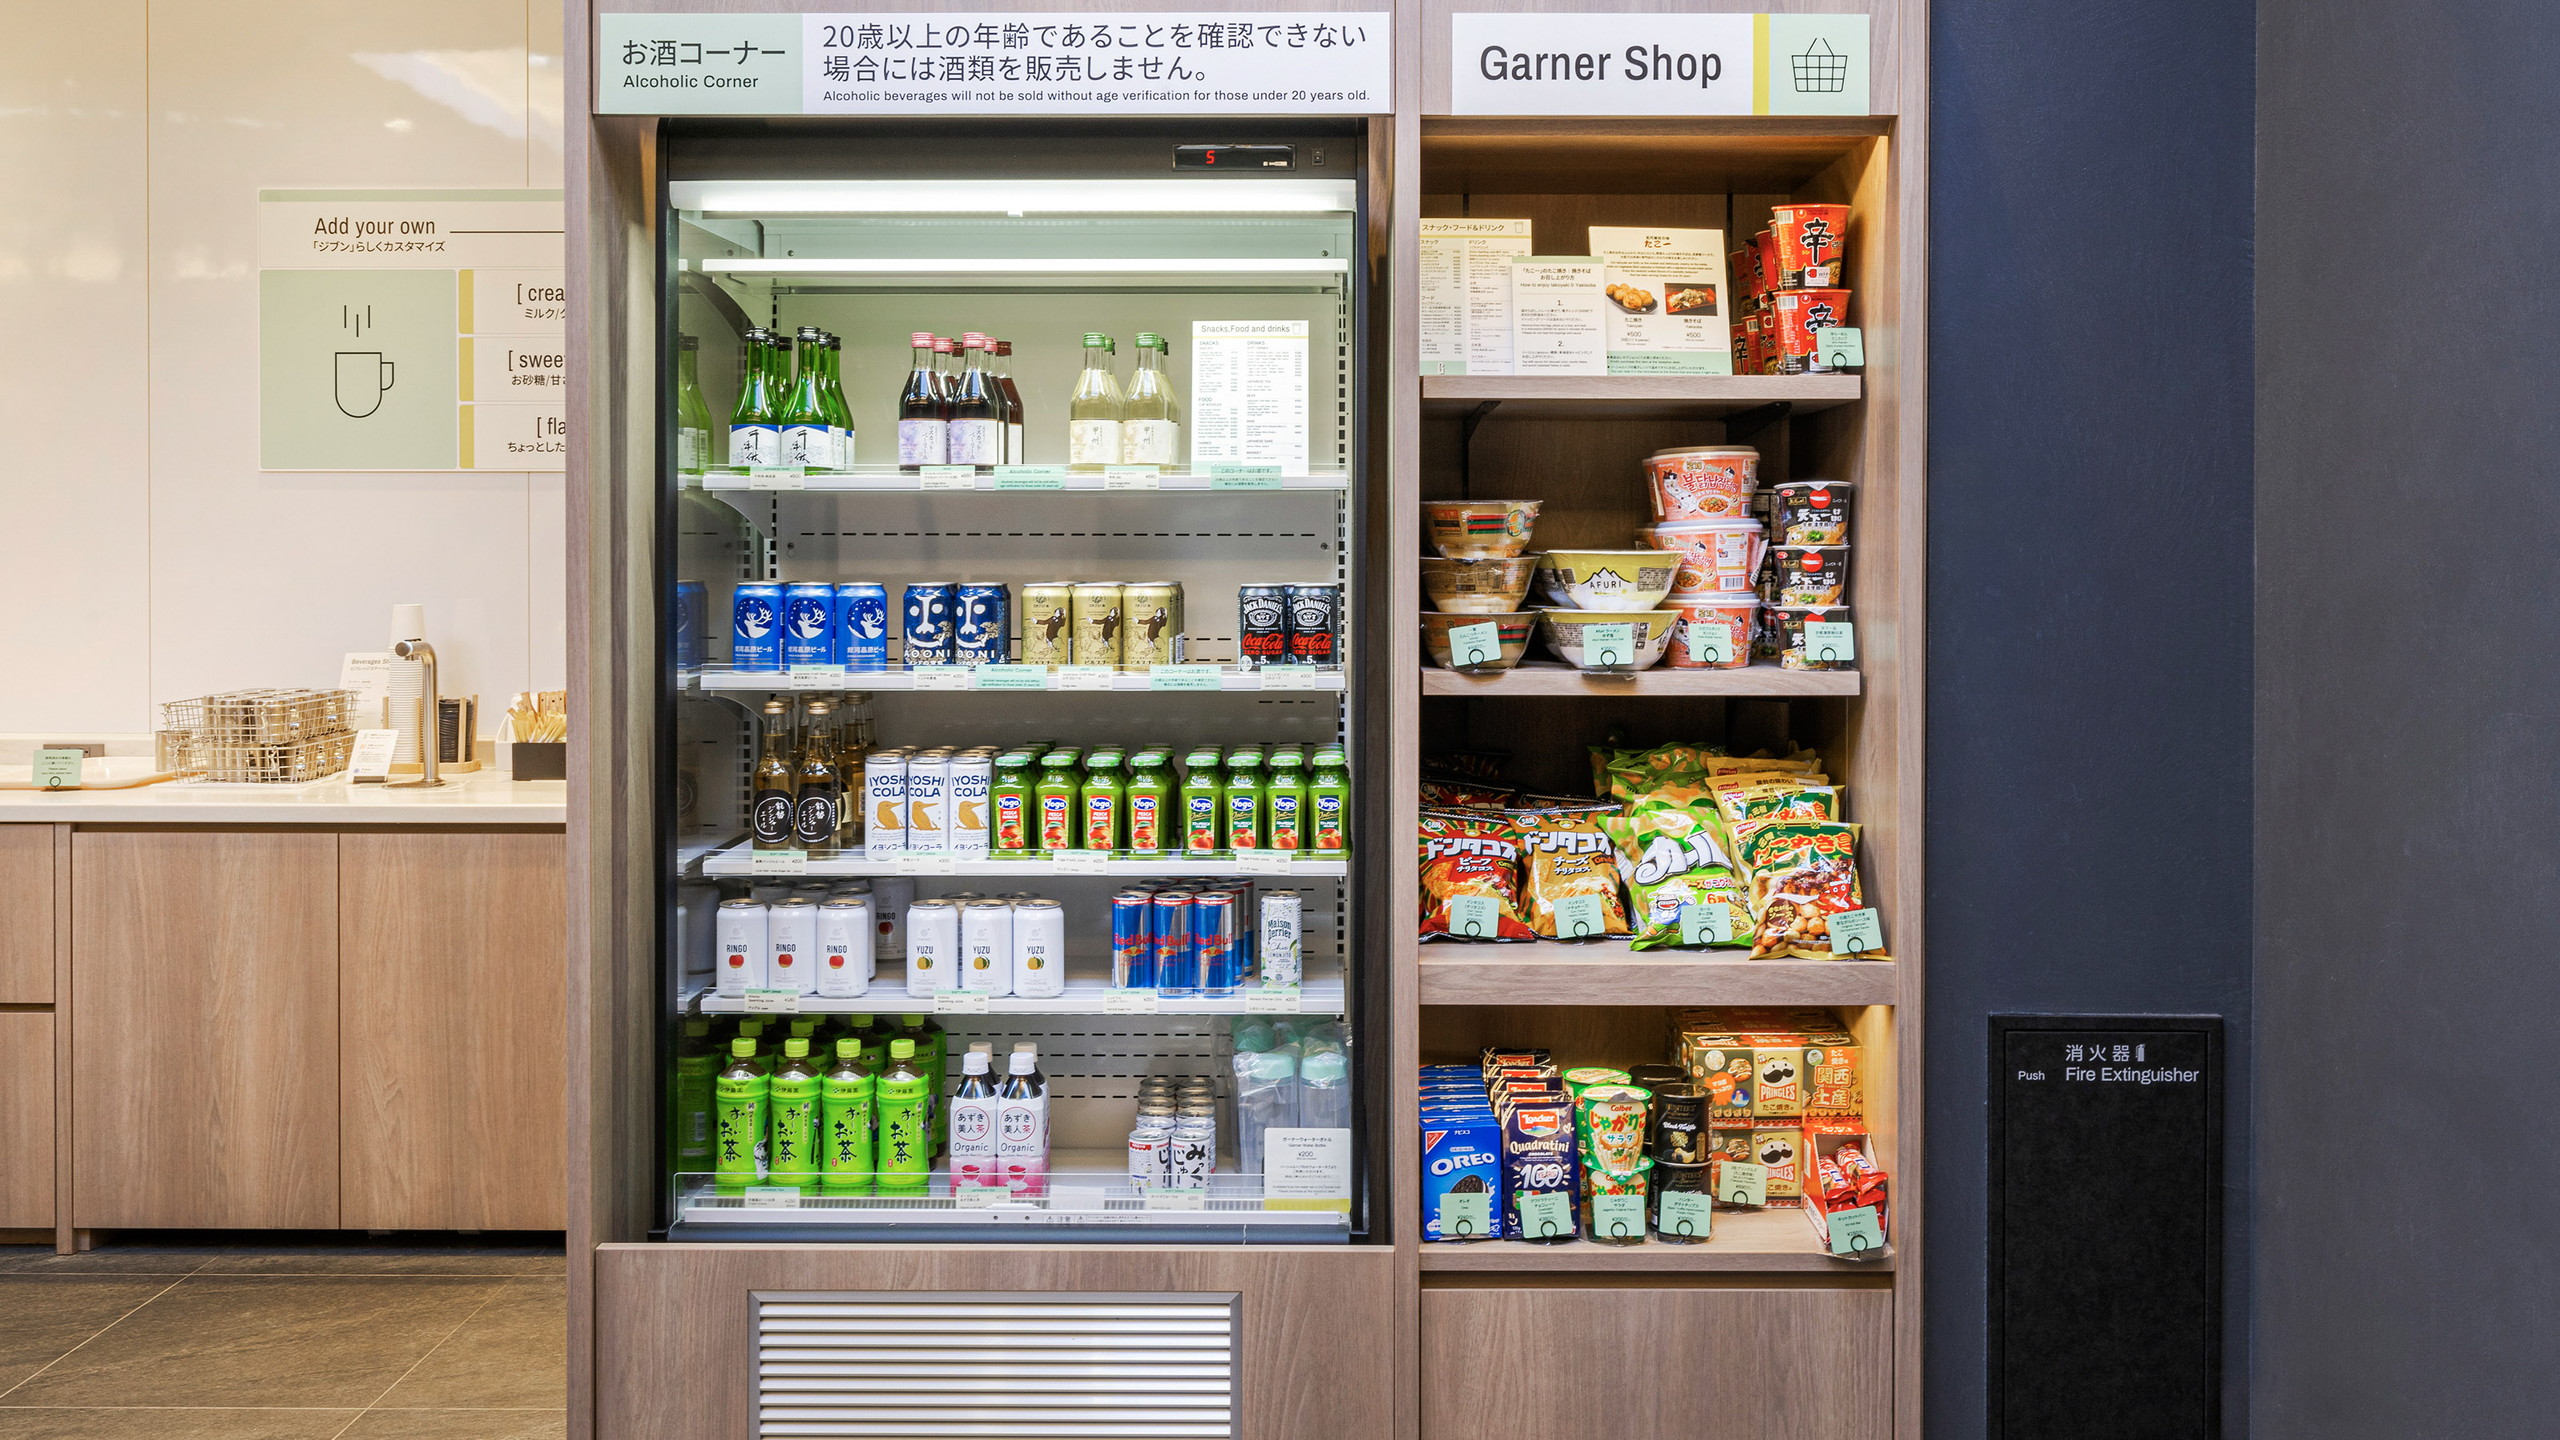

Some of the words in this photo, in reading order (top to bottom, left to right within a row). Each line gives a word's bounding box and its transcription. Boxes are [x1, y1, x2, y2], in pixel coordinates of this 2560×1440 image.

[823, 22, 1366, 50] 20歳以上の年齢であることを確認できない
[623, 39, 786, 67] お酒コーナー
[823, 54, 1205, 83] 場合には酒類を販売しません。
[1480, 45, 1612, 81] Garner
[1624, 44, 1722, 89] Shop
[623, 74, 698, 88] Alcoholic
[704, 74, 759, 88] Corner
[823, 90, 880, 101] Alcoholic
[884, 90, 948, 104] beverages
[951, 90, 972, 101] will
[975, 91, 995, 101] not
[999, 90, 1014, 101] be
[1017, 90, 1043, 101] sold
[1047, 90, 1093, 101] without
[1096, 91, 1119, 103] age
[1122, 90, 1190, 101] verification
[1193, 90, 1211, 101] for
[1214, 90, 1249, 101] those
[1252, 90, 1288, 101] under
[1291, 90, 1306, 101] 20
[1310, 92, 1344, 103] years
[1347, 90, 1371, 101] old.
[1205, 150, 1216, 165] 5
[314, 216, 349, 235] Add
[355, 221, 395, 239] your
[400, 221, 436, 235] own
[312, 240, 446, 253] 「ジブン」らしくカスタマイズ
[1801, 217, 1834, 265] 辛
[1251, 325, 1266, 333] and
[1267, 325, 1290, 333] drinks
[1590, 580, 1622, 589] AFURI
[1243, 599, 1258, 615] JACK
[1258, 598, 1283, 614] DANIEL'S
[1292, 599, 1305, 615] JACK
[1305, 598, 1332, 614] DANIEL'S
[1241, 633, 1284, 650] Coca-Cola
[1292, 633, 1334, 650] Coca-Cola
[903, 649, 951, 658] AOONI
[351, 658, 381, 666] Beverages
[872, 786, 906, 797] COLA
[954, 786, 988, 797] COLA
[1000, 798, 1021, 808] Yoga
[1044, 799, 1066, 809] Yoga
[1089, 799, 1111, 809] Yoga
[1133, 799, 1155, 809] Yoga
[1190, 800, 1212, 810] Yoga
[1231, 799, 1253, 809] Yoga
[1274, 799, 1296, 809] Yoga
[1317, 799, 1339, 809] Yoga
[1522, 831, 1613, 855] ドンタコス
[1426, 837, 1517, 862] ドンタコス
[1458, 856, 1492, 866] ビーフ
[1553, 855, 1589, 867] チーズ
[876, 911, 896, 922] RINGO
[1267, 919, 1292, 930] Maison
[1113, 932, 1134, 946] Red
[1167, 931, 1191, 947] Bull
[1267, 929, 1292, 945] Perrier
[726, 944, 748, 953] RINGO
[775, 943, 797, 952] RINGO
[826, 944, 848, 954] RINGO
[916, 945, 934, 955] YUZU
[973, 945, 991, 955] YUZU
[1026, 945, 1045, 955] YUZU
[2064, 1043, 2131, 1063] 消火器
[1815, 1067, 1850, 1086] 関西
[2017, 1070, 2046, 1082] Push
[2064, 1066, 2097, 1083] Fire
[2101, 1066, 2201, 1086] Extinguisher
[1760, 1084, 1796, 1102] PRINGLES
[1813, 1088, 1850, 1108] 土産
[1610, 1104, 1633, 1112] Calbee
[957, 1113, 985, 1123] あずき
[1004, 1113, 1031, 1123] あずき
[1521, 1113, 1555, 1125] Loacker
[1589, 1110, 1647, 1132] じゃがりこ
[957, 1124, 985, 1134] 美人茶
[1004, 1124, 1031, 1134] 美人茶
[1607, 1133, 1635, 1142] サラダ
[954, 1142, 989, 1153] Organic
[1000, 1142, 1035, 1153] Organic
[1509, 1140, 1570, 1155] Quadratini
[1430, 1152, 1496, 1177] OREO
[1519, 1163, 1564, 1189] 100
